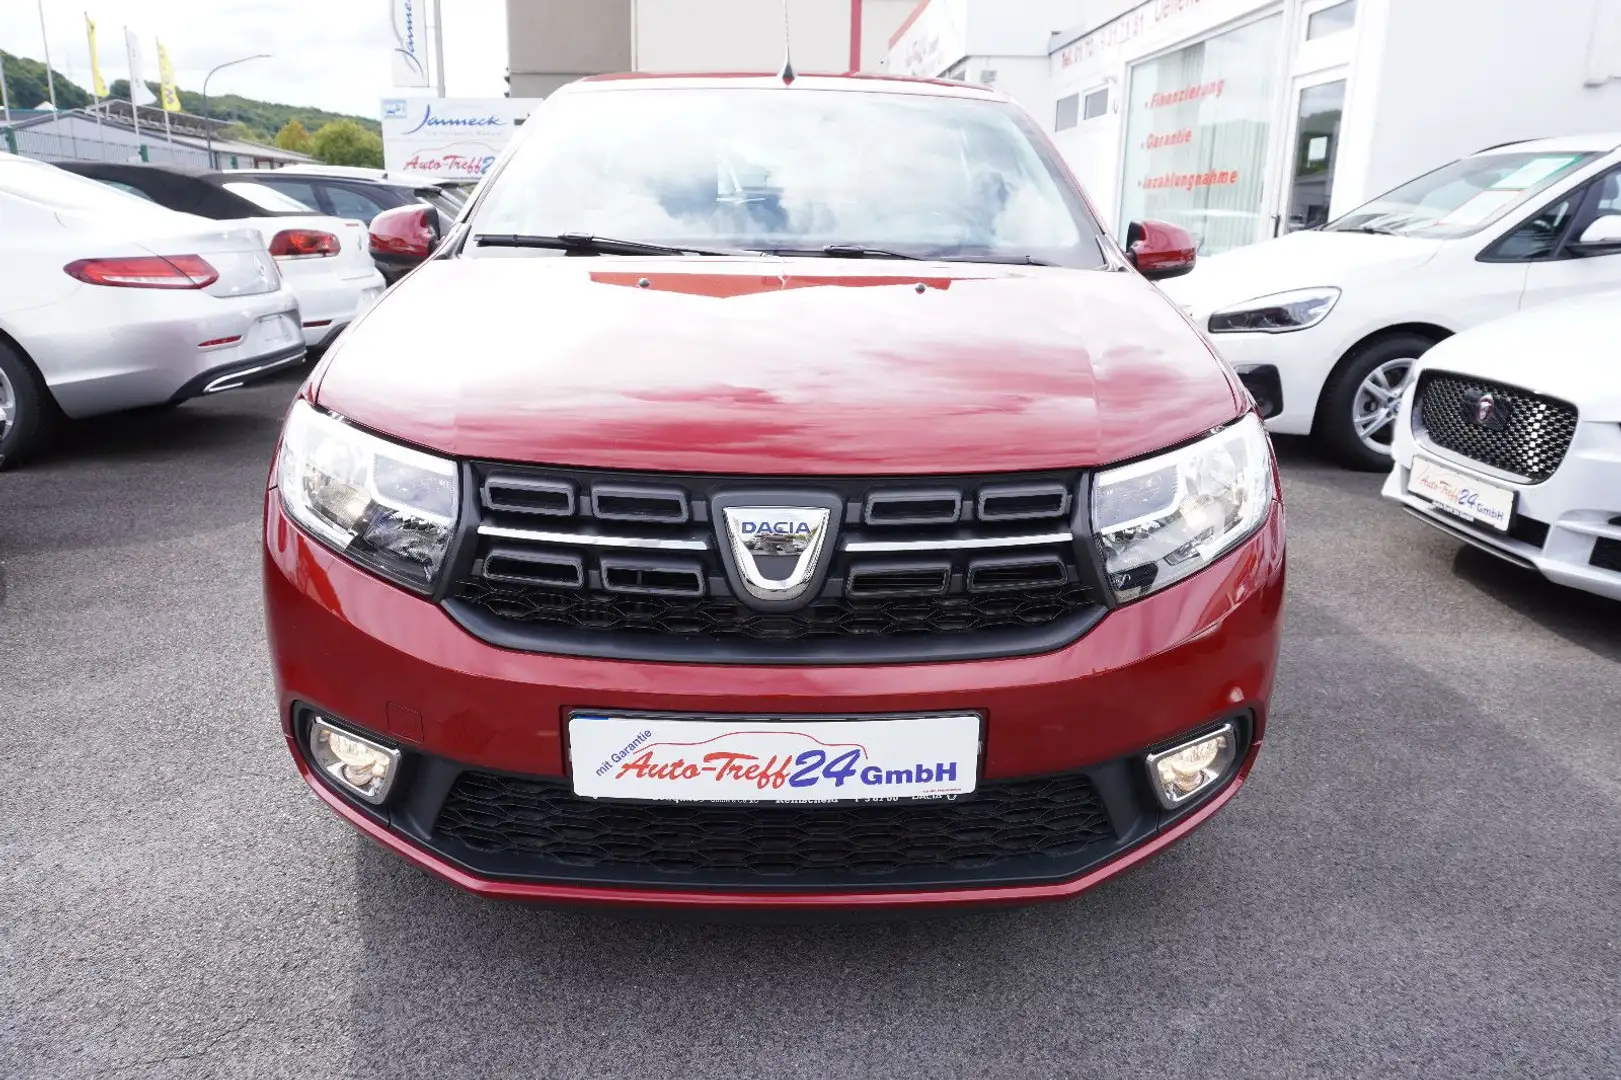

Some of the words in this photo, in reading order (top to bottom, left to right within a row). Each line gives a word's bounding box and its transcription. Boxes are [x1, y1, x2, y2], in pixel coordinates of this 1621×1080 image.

[394, 0, 424, 79] Janne
[1150, 80, 1225, 108] Finanzierung
[1146, 128, 1192, 149] Garantie
[403, 155, 496, 175] Auto-Treff2
[1477, 503, 1504, 521] GmbH
[741, 521, 811, 534] DACIA
[596, 761, 613, 777] mit
[610, 729, 652, 763] Garantie
[615, 749, 861, 789] Auto-Treff24
[860, 762, 957, 785] GmbH
